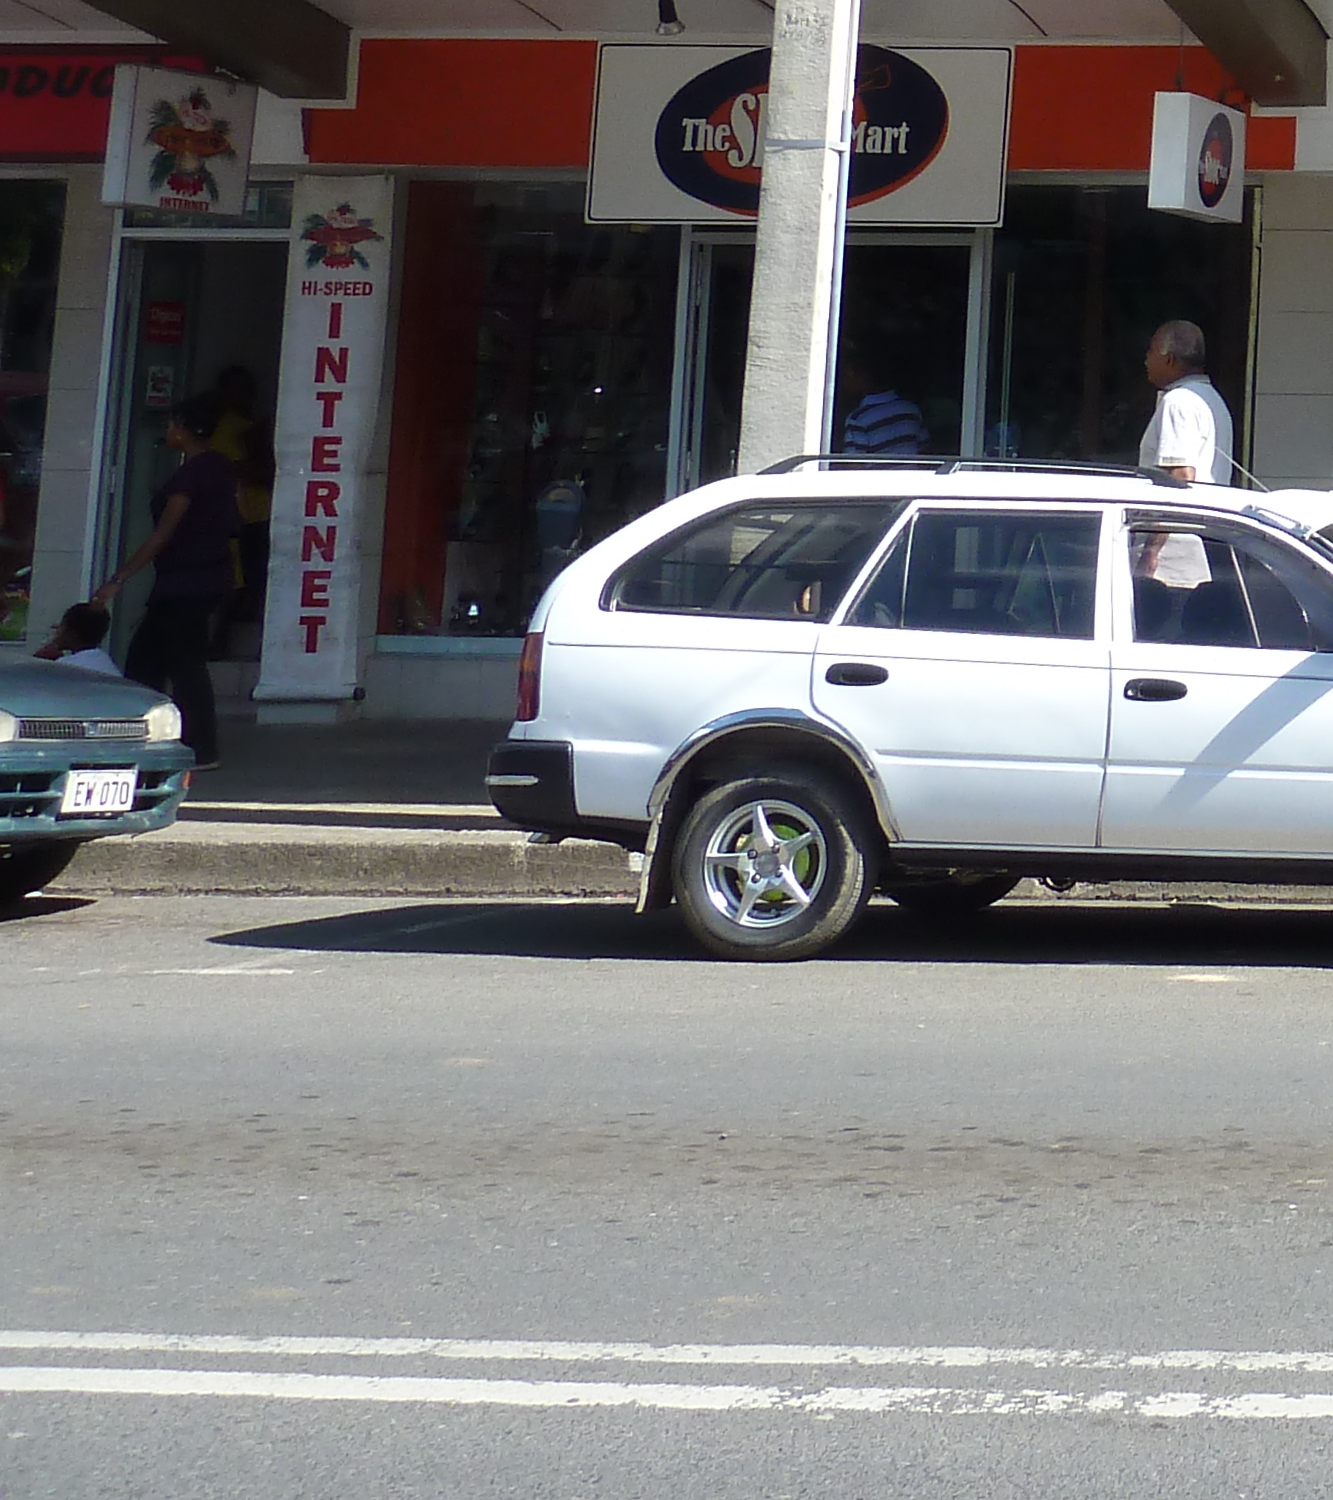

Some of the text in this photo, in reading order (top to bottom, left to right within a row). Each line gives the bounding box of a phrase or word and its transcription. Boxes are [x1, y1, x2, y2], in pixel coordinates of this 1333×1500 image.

[681, 118, 731, 151] The
[302, 281, 373, 296] HI-SPEED
[298, 302, 349, 653] INTERNET
[73, 781, 130, 806] EW 070
